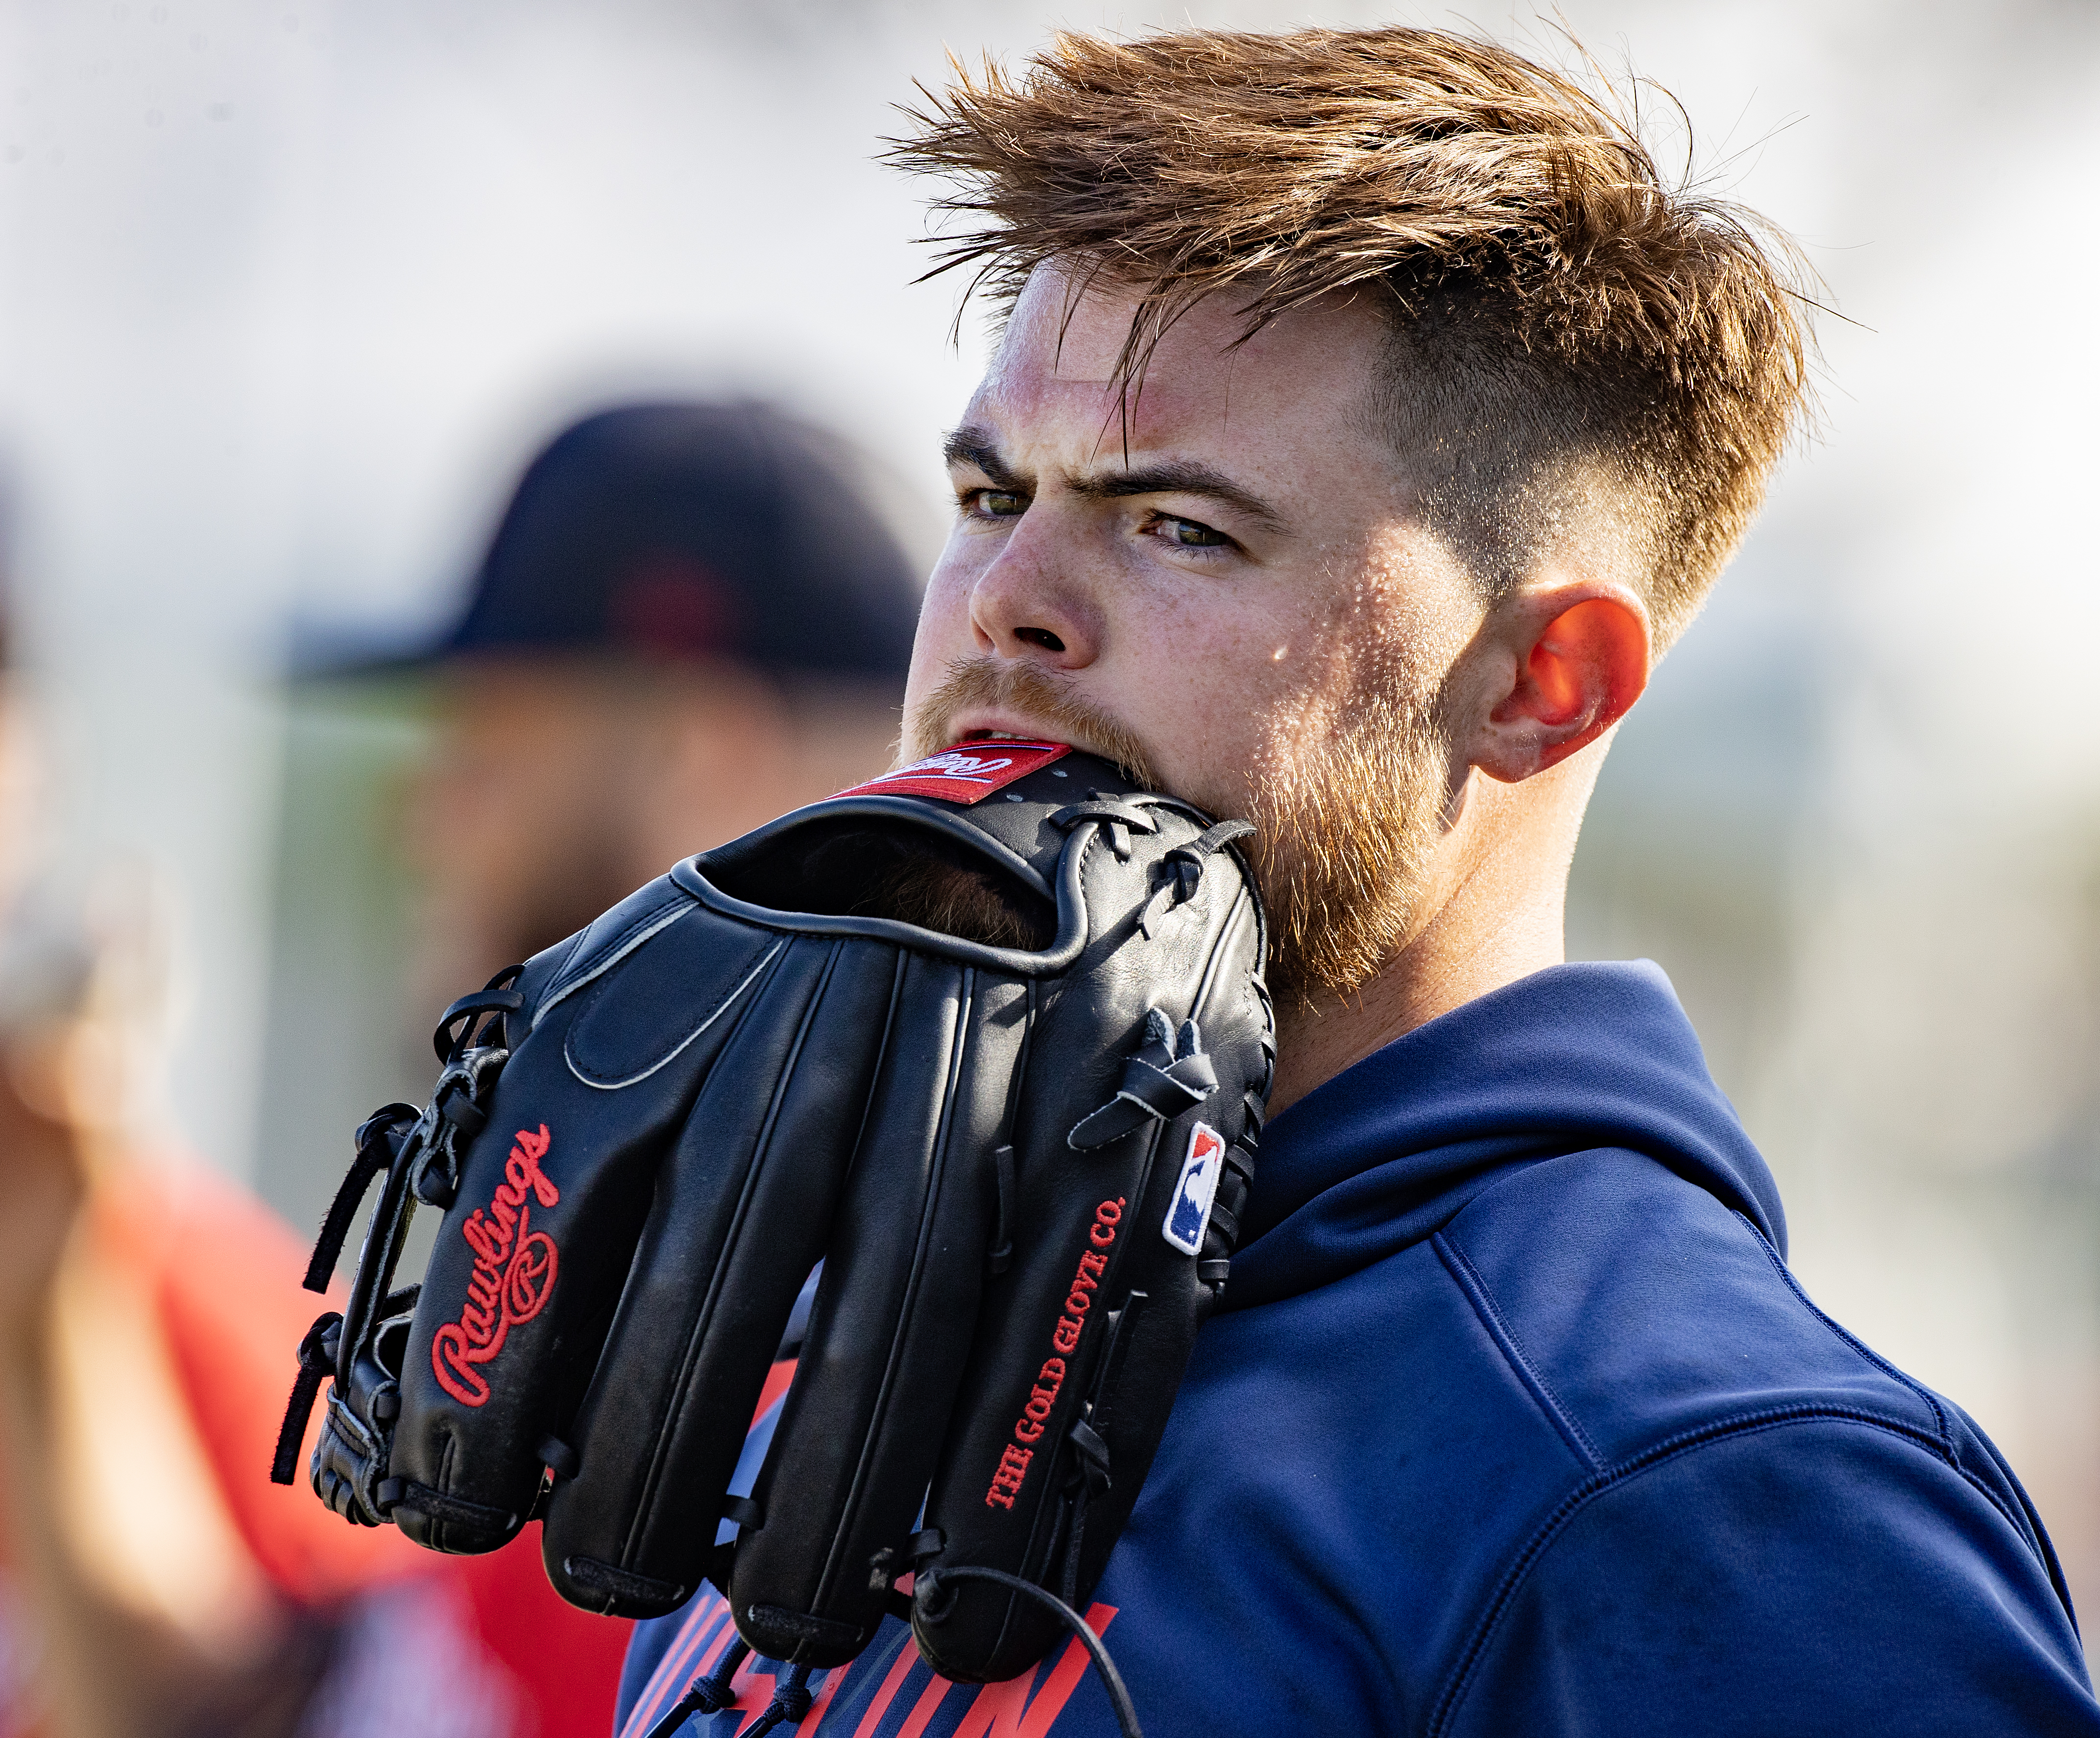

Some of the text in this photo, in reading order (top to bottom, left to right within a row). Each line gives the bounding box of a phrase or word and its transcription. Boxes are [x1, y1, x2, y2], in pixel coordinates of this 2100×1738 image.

[432, 1124, 559, 1406] Rawlings
[986, 1197, 1126, 1509] THE GOLD GLOVE CO.
